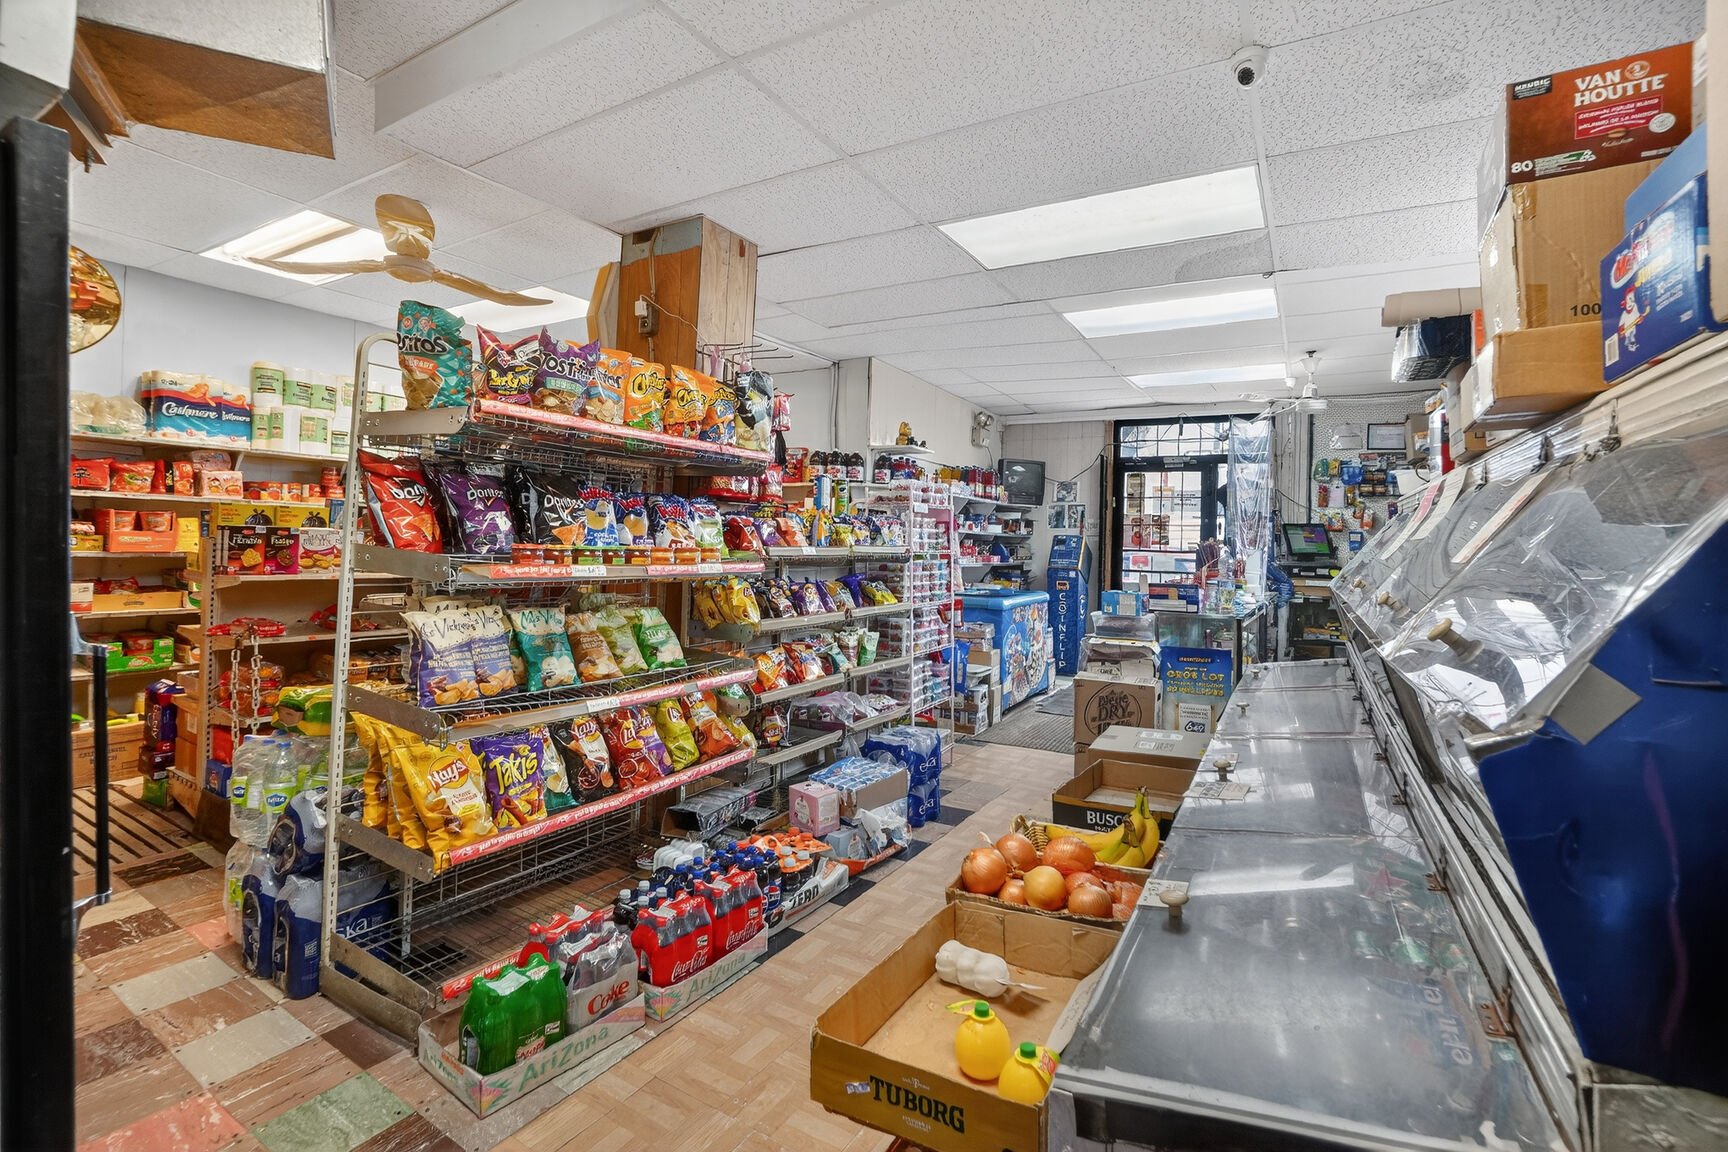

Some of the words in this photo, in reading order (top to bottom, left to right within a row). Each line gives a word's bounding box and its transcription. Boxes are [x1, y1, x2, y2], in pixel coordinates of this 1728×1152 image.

[1574, 73, 1668, 107] HOUTTE
[1575, 69, 1621, 91] VAN
[1511, 160, 1534, 173] 80
[162, 401, 218, 419] Cashmere
[489, 751, 536, 794] Takis
[1087, 810, 1128, 827] BUSC
[588, 980, 630, 1016] Coke
[518, 1027, 609, 1092] AriZona
[869, 1074, 965, 1134] TUBORG
